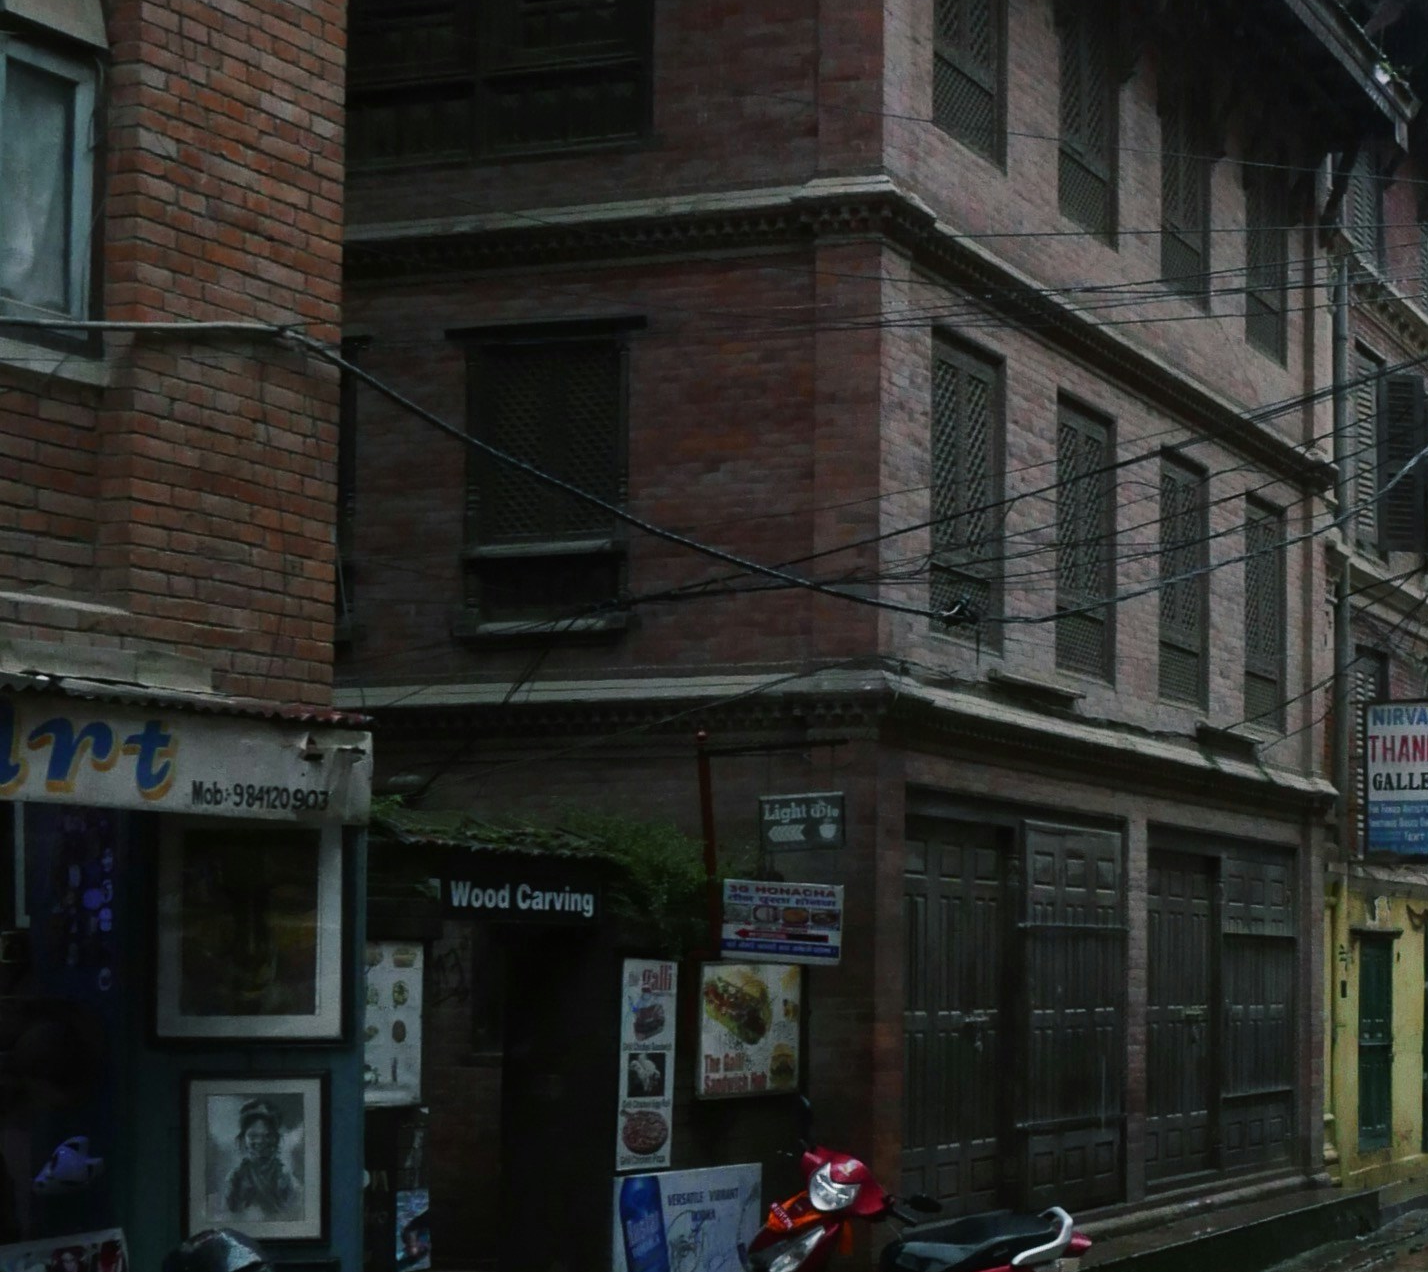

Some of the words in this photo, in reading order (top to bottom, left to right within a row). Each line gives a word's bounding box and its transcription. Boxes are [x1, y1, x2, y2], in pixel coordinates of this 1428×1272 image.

[764, 802, 807, 823] Light
[450, 880, 510, 909] Wood
[516, 884, 594, 918] Carving
[755, 886, 836, 898] HONACHA
[704, 1054, 720, 1073] The
[668, 1191, 704, 1206] VERSATILE
